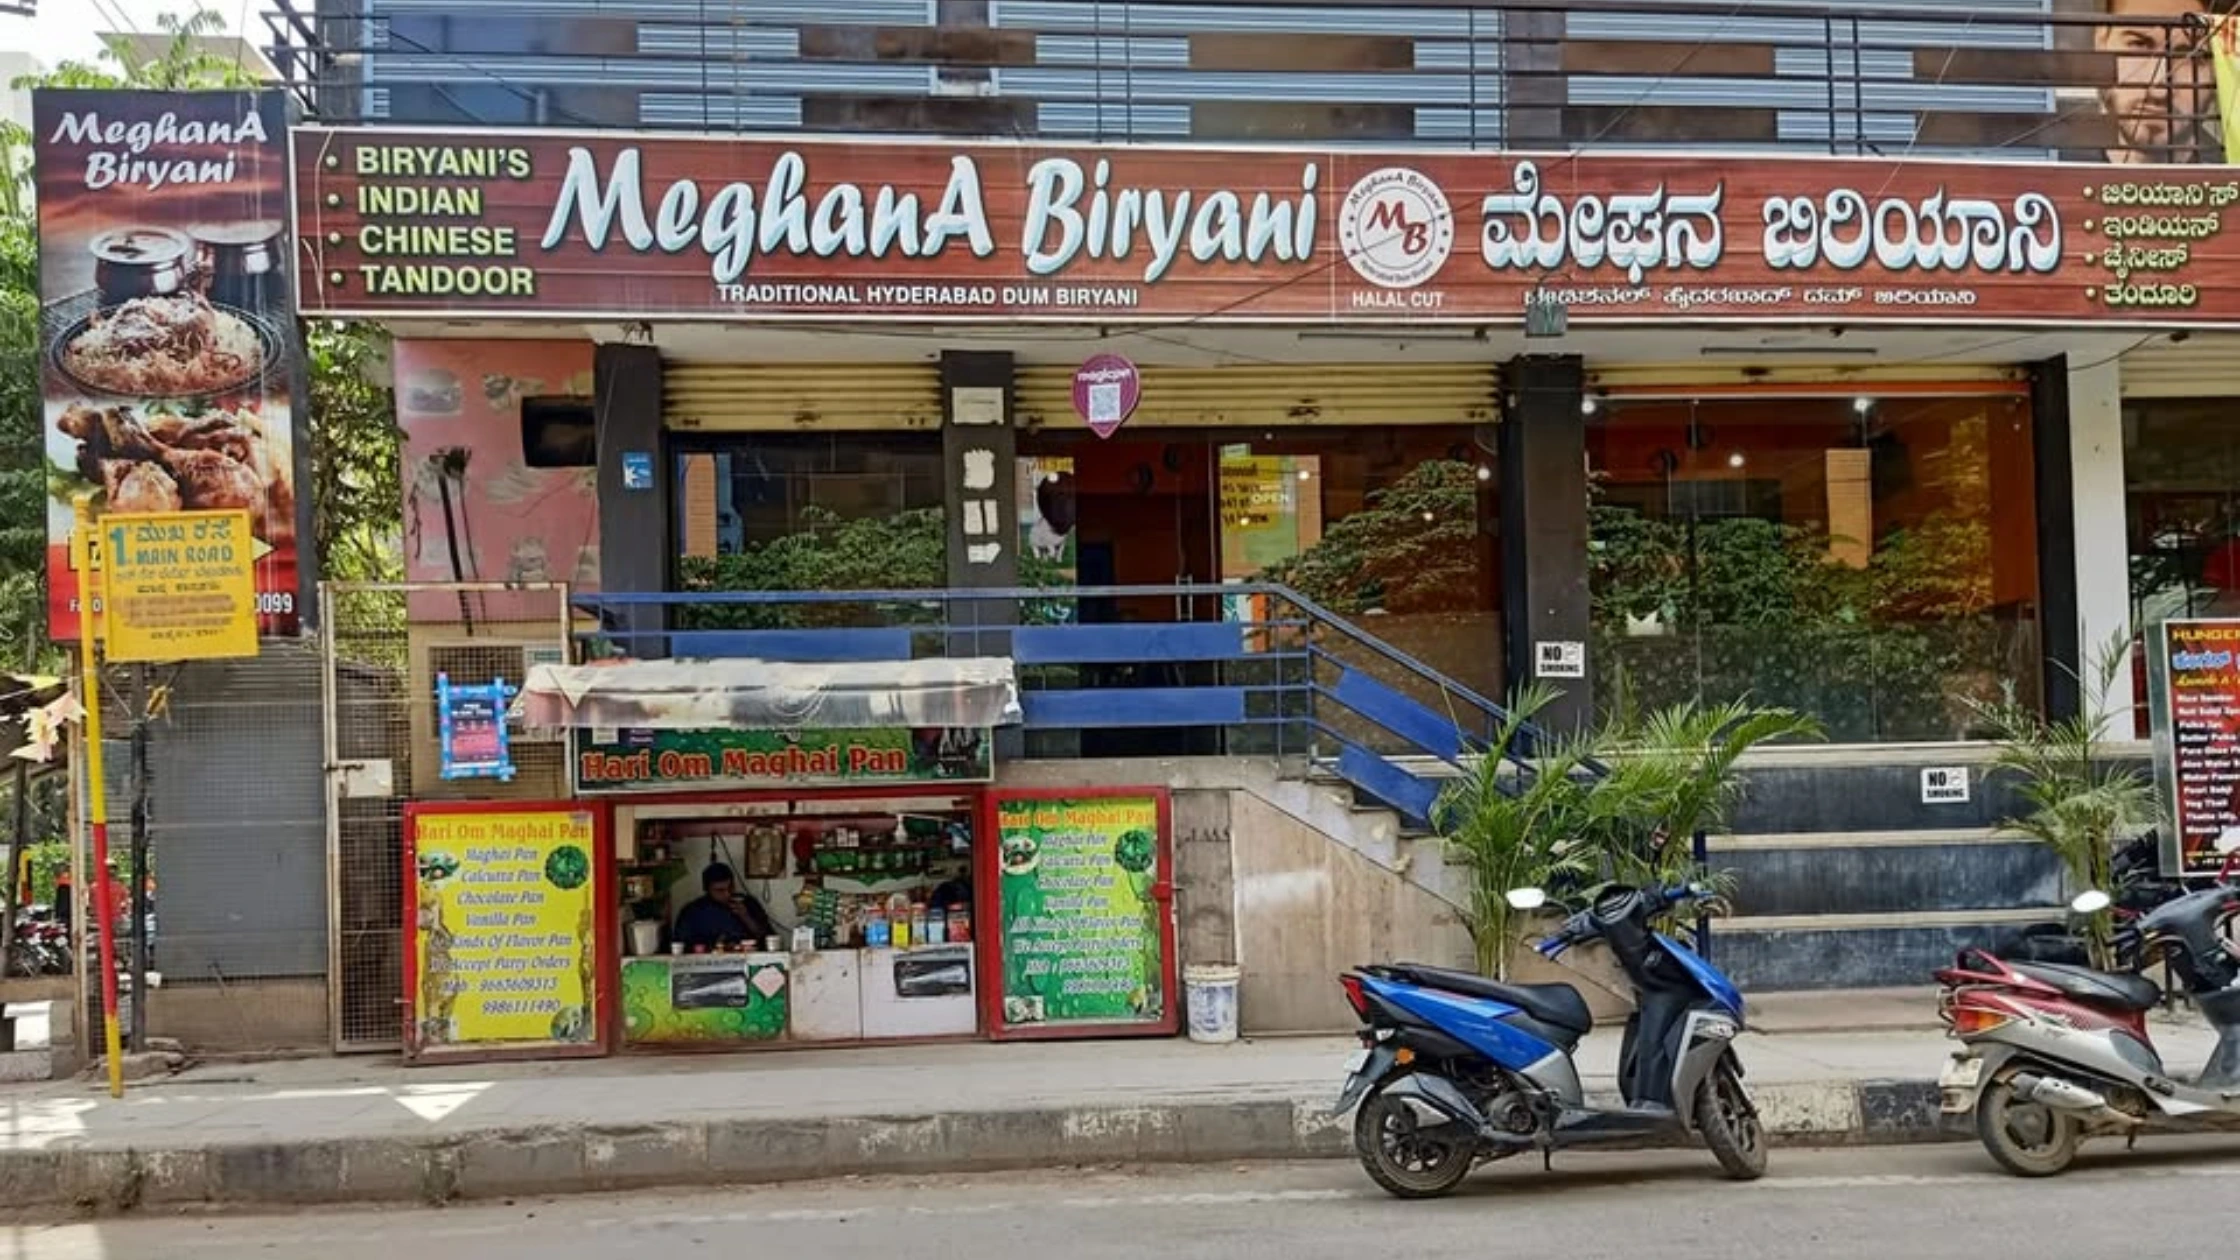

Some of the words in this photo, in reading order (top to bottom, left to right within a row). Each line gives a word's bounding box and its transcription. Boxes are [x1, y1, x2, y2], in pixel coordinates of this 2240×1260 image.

[50, 111, 267, 151] MeghanA
[85, 150, 235, 190] Biryani
[356, 147, 531, 178] BIRYANI'S
[358, 186, 481, 215] INDIAN
[541, 146, 994, 284] MeghanA
[1022, 156, 1318, 283] Biryani
[359, 226, 515, 256] CHINESE
[1763, 184, 2061, 272] ಬಿರಿಯಾನಿ
[360, 265, 535, 296] TANDOOR
[716, 284, 861, 304] TRADITIONAL
[867, 285, 997, 306] HYDERABAD
[1003, 287, 1049, 306] DUM
[1057, 287, 1138, 307] BIRYANI
[1352, 291, 1405, 307] HALAL
[1411, 290, 1444, 307] CUT
[136, 548, 179, 566] MAIN
[186, 545, 233, 563] ROAD
[1542, 645, 1562, 661] NO
[1540, 664, 1580, 673] SMOKING
[580, 749, 651, 782] Hari
[657, 750, 712, 779] Om
[722, 743, 839, 778] Maghai
[848, 746, 906, 773] Pan
[1927, 788, 1963, 798] SMOKING
[1928, 771, 1947, 787] NO
[457, 824, 486, 840] Om
[491, 822, 555, 842] Maghai
[559, 822, 590, 839] Pan
